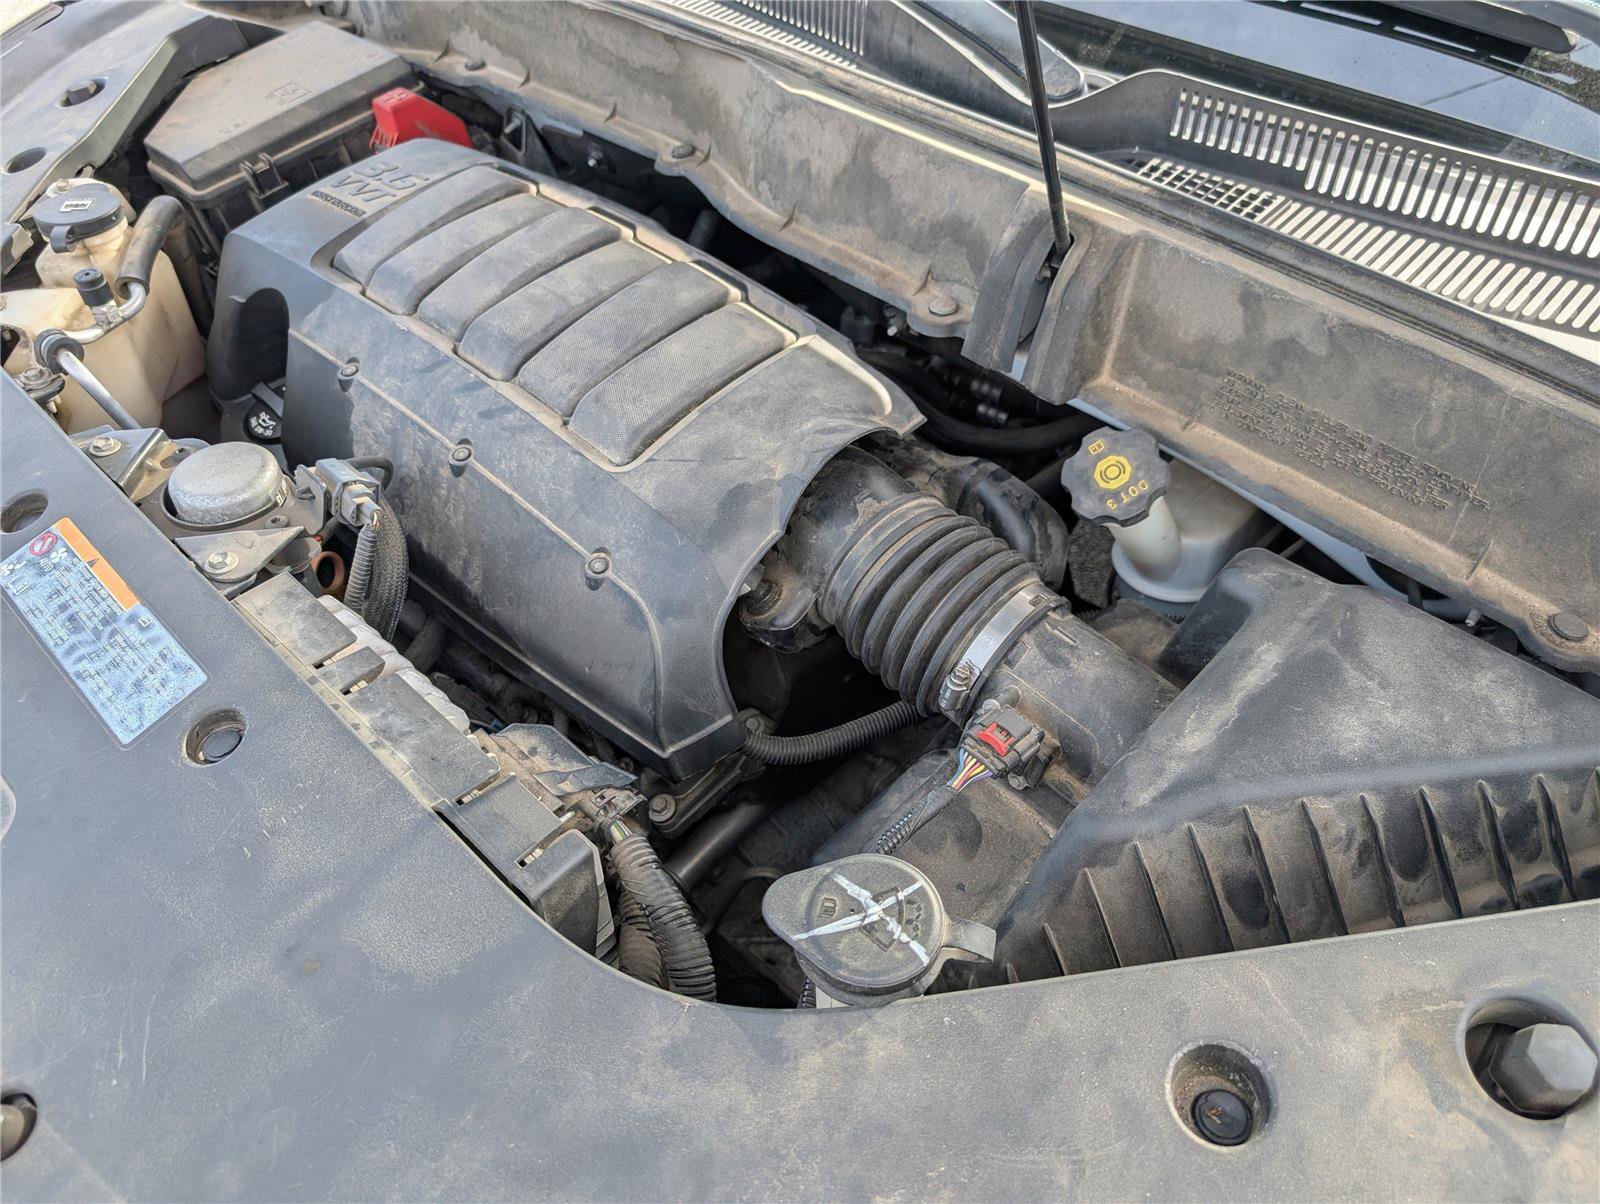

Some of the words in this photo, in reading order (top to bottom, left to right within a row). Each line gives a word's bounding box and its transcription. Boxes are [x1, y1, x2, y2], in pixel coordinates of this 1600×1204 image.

[330, 175, 397, 203] VVT
[1121, 480, 1148, 504] DOT
[1106, 499, 1117, 511] 3
